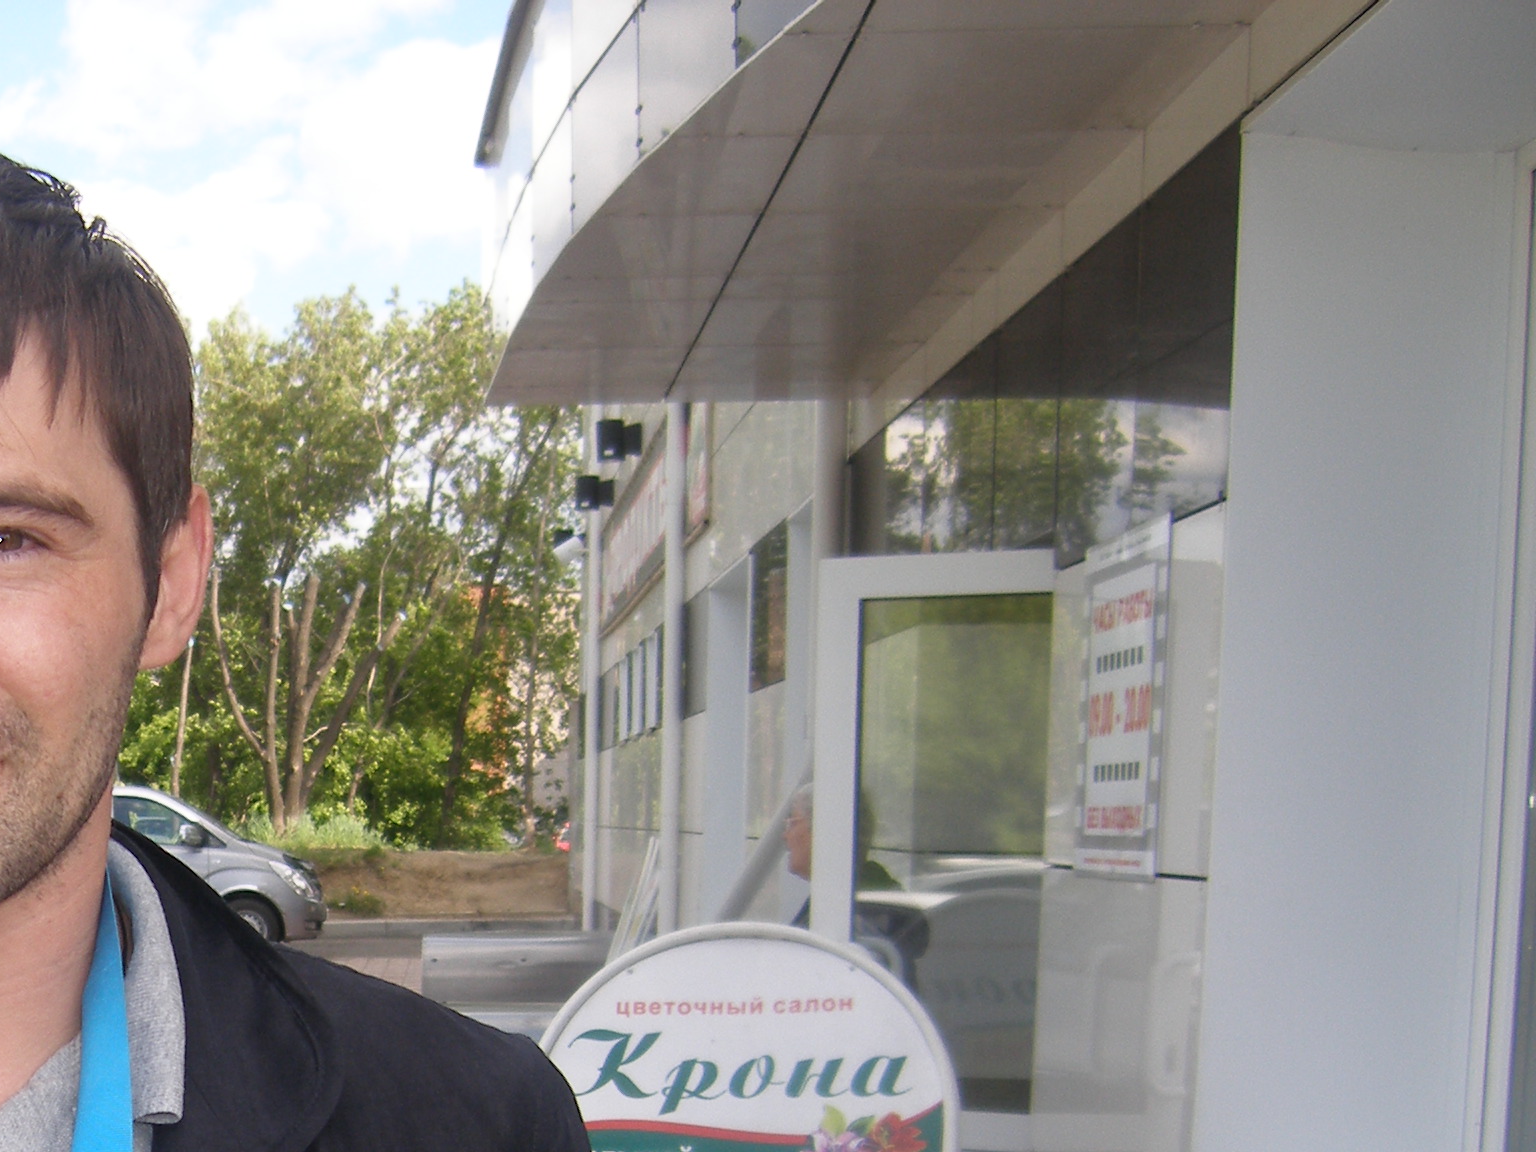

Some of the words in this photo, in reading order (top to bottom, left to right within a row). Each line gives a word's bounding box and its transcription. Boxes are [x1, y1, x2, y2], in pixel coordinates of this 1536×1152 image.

[616, 997, 763, 1018] цветочный
[773, 996, 854, 1015] салон
[568, 1028, 913, 1116] Крона
